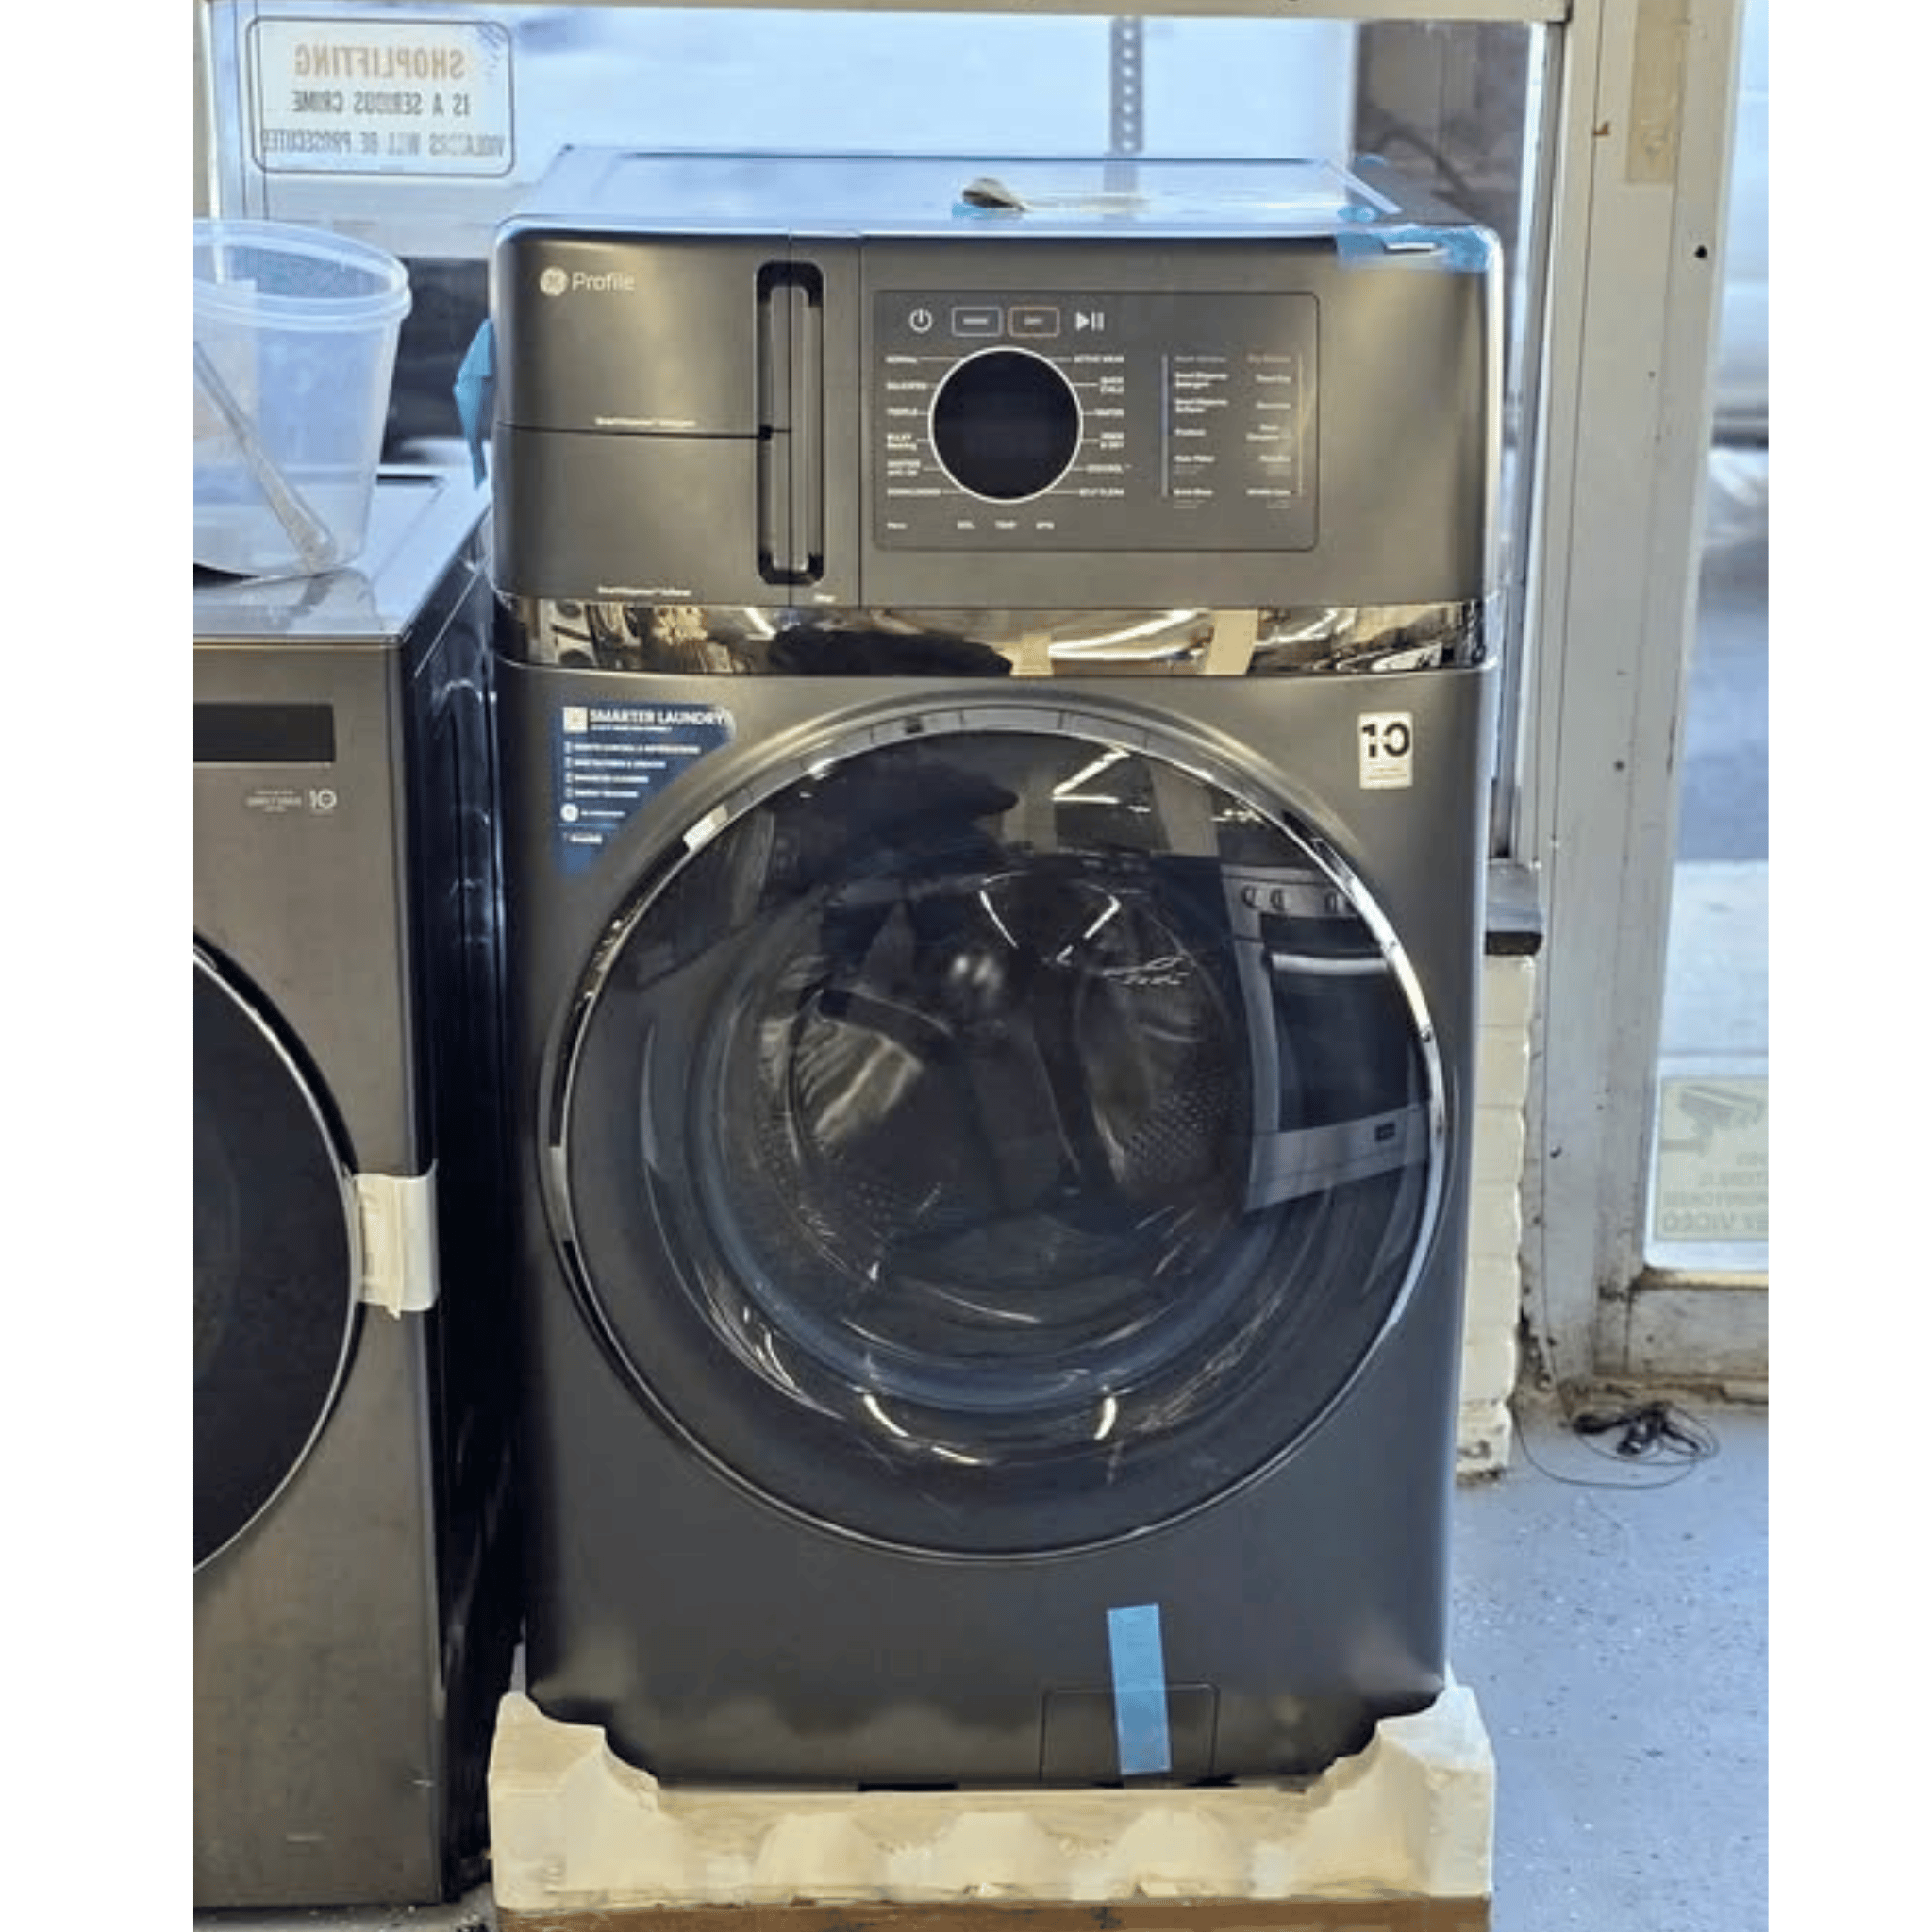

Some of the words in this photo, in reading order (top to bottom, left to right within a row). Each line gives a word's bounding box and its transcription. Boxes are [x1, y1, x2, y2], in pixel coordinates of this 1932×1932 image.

[571, 270, 635, 292] Profile
[589, 708, 656, 724] SMARTER
[657, 710, 725, 726] LAUNDRY
[1361, 722, 1410, 758] 10
